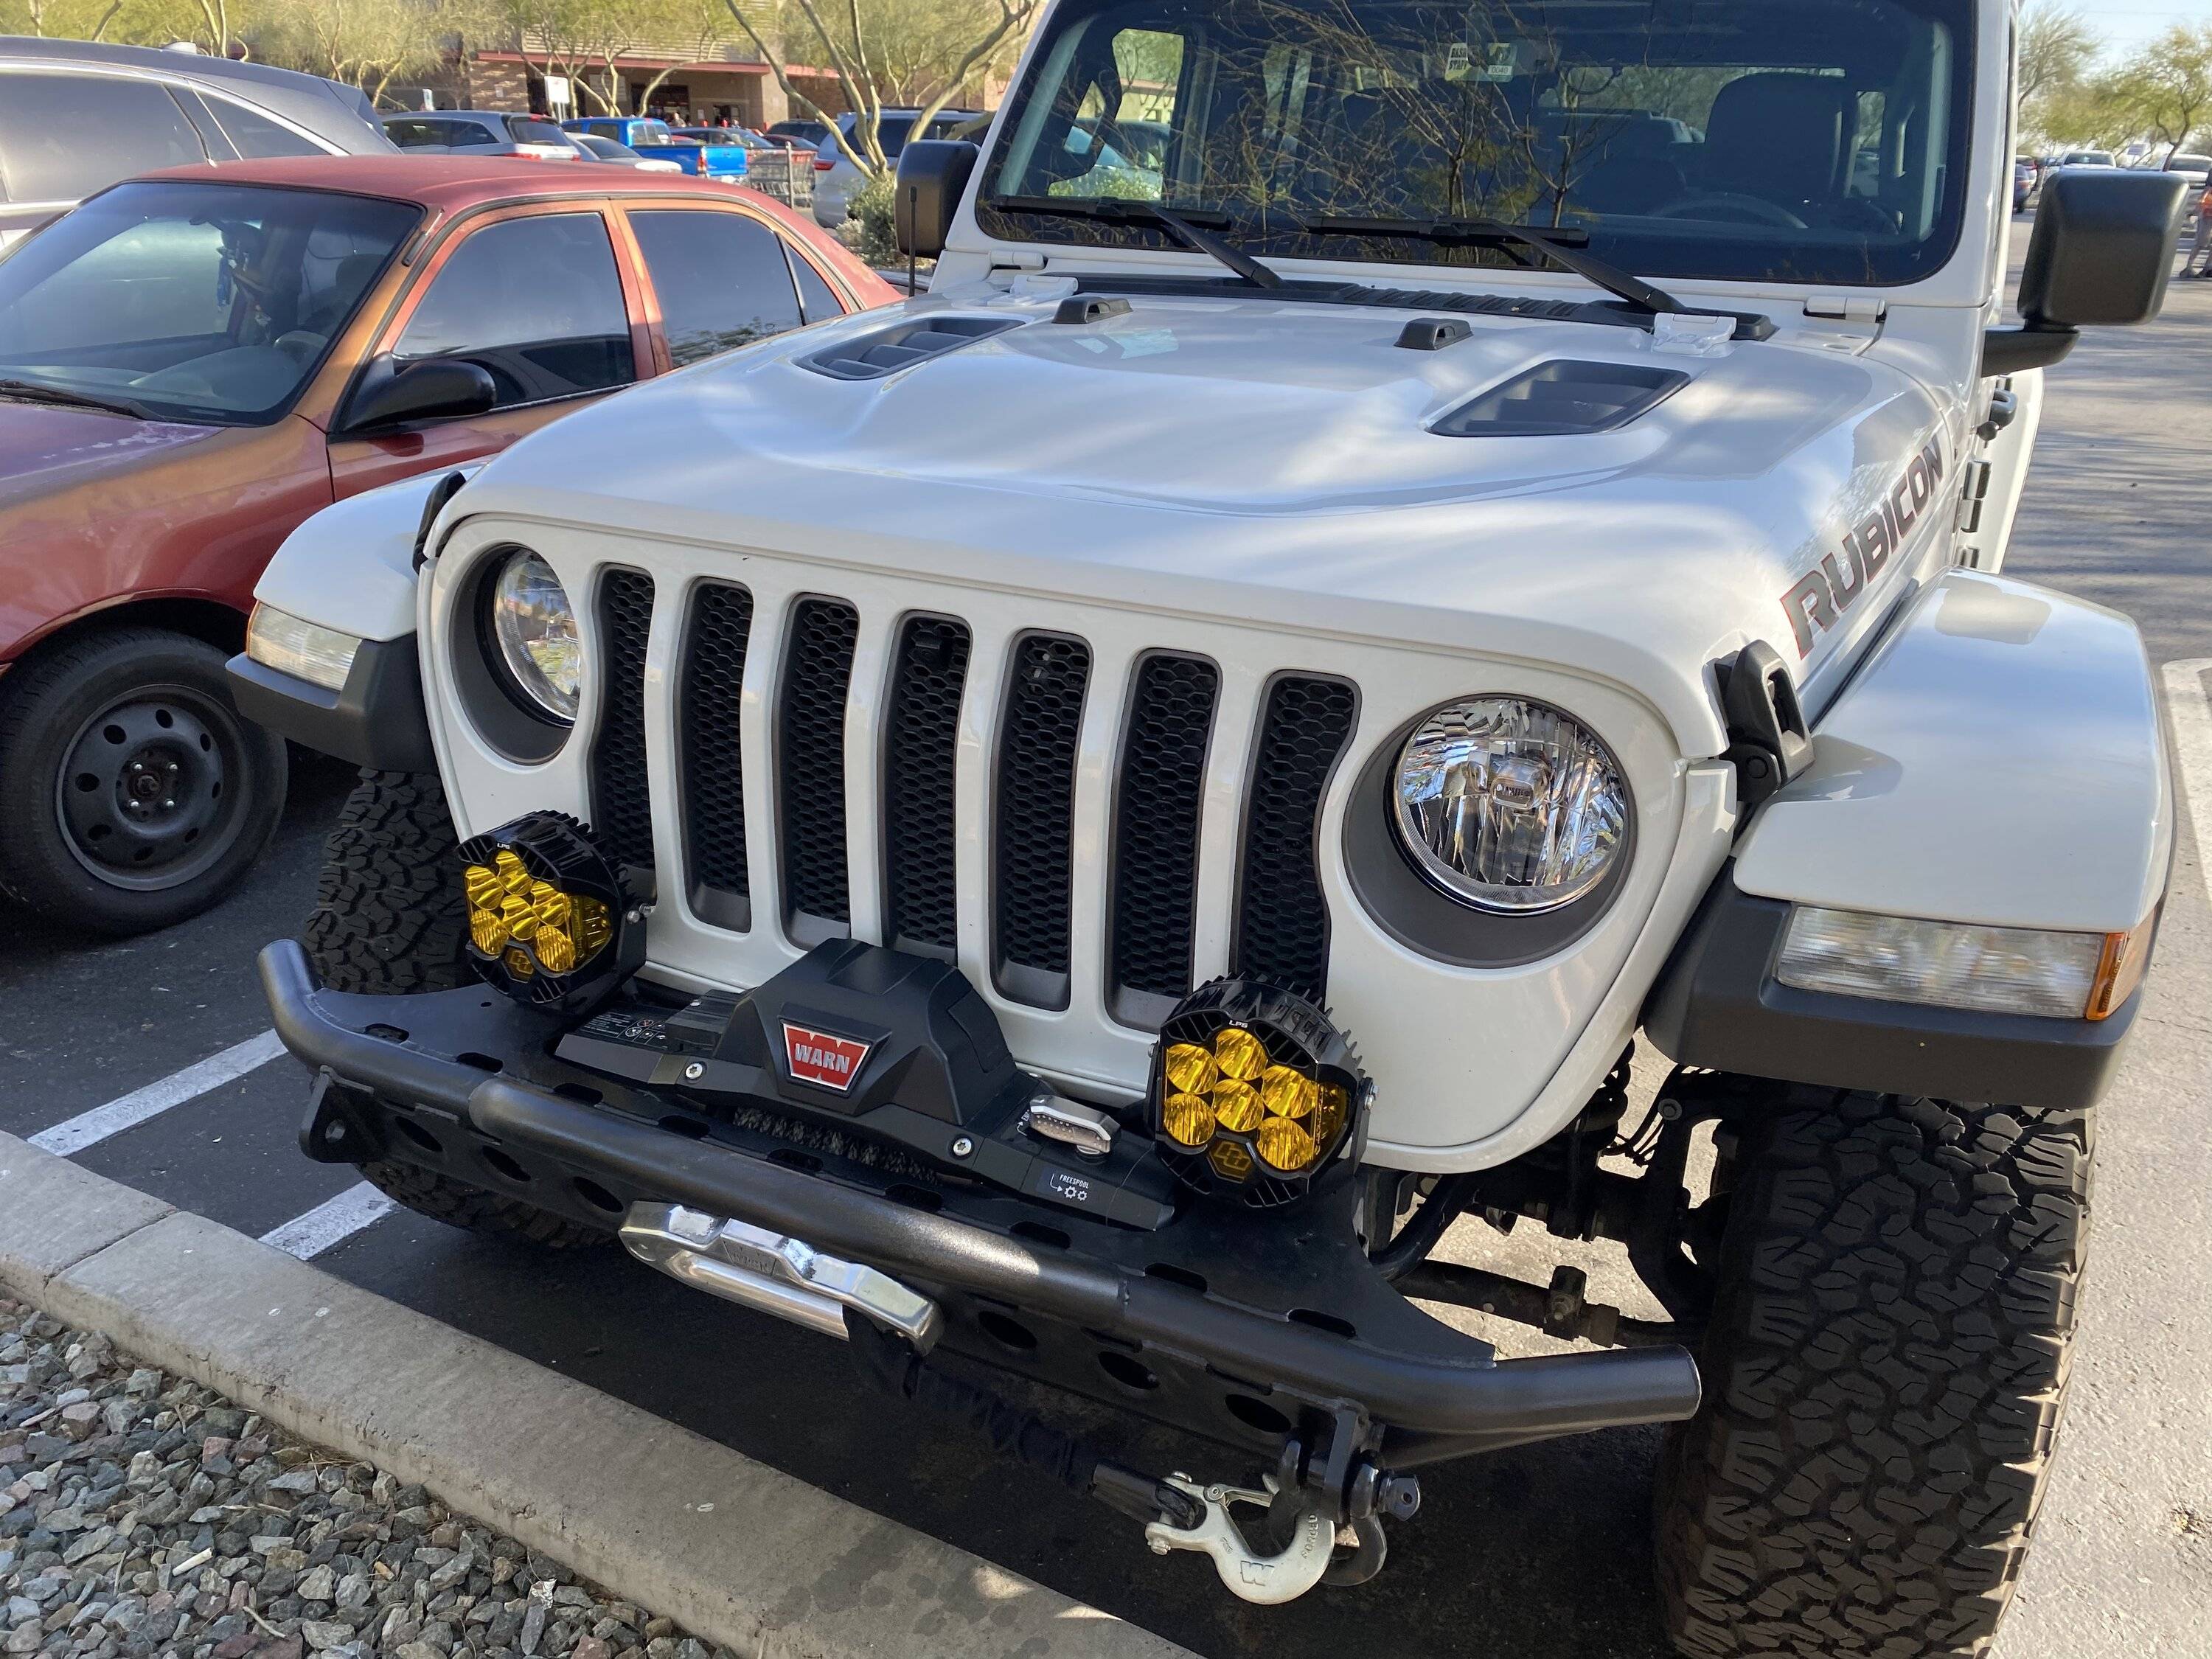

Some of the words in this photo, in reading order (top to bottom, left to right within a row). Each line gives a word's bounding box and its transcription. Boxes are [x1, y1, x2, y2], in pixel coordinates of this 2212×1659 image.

[1779, 434, 1944, 660] RUBICON
[795, 1043, 850, 1074] WARN
[1059, 1174, 1089, 1189] FREESPOOL
